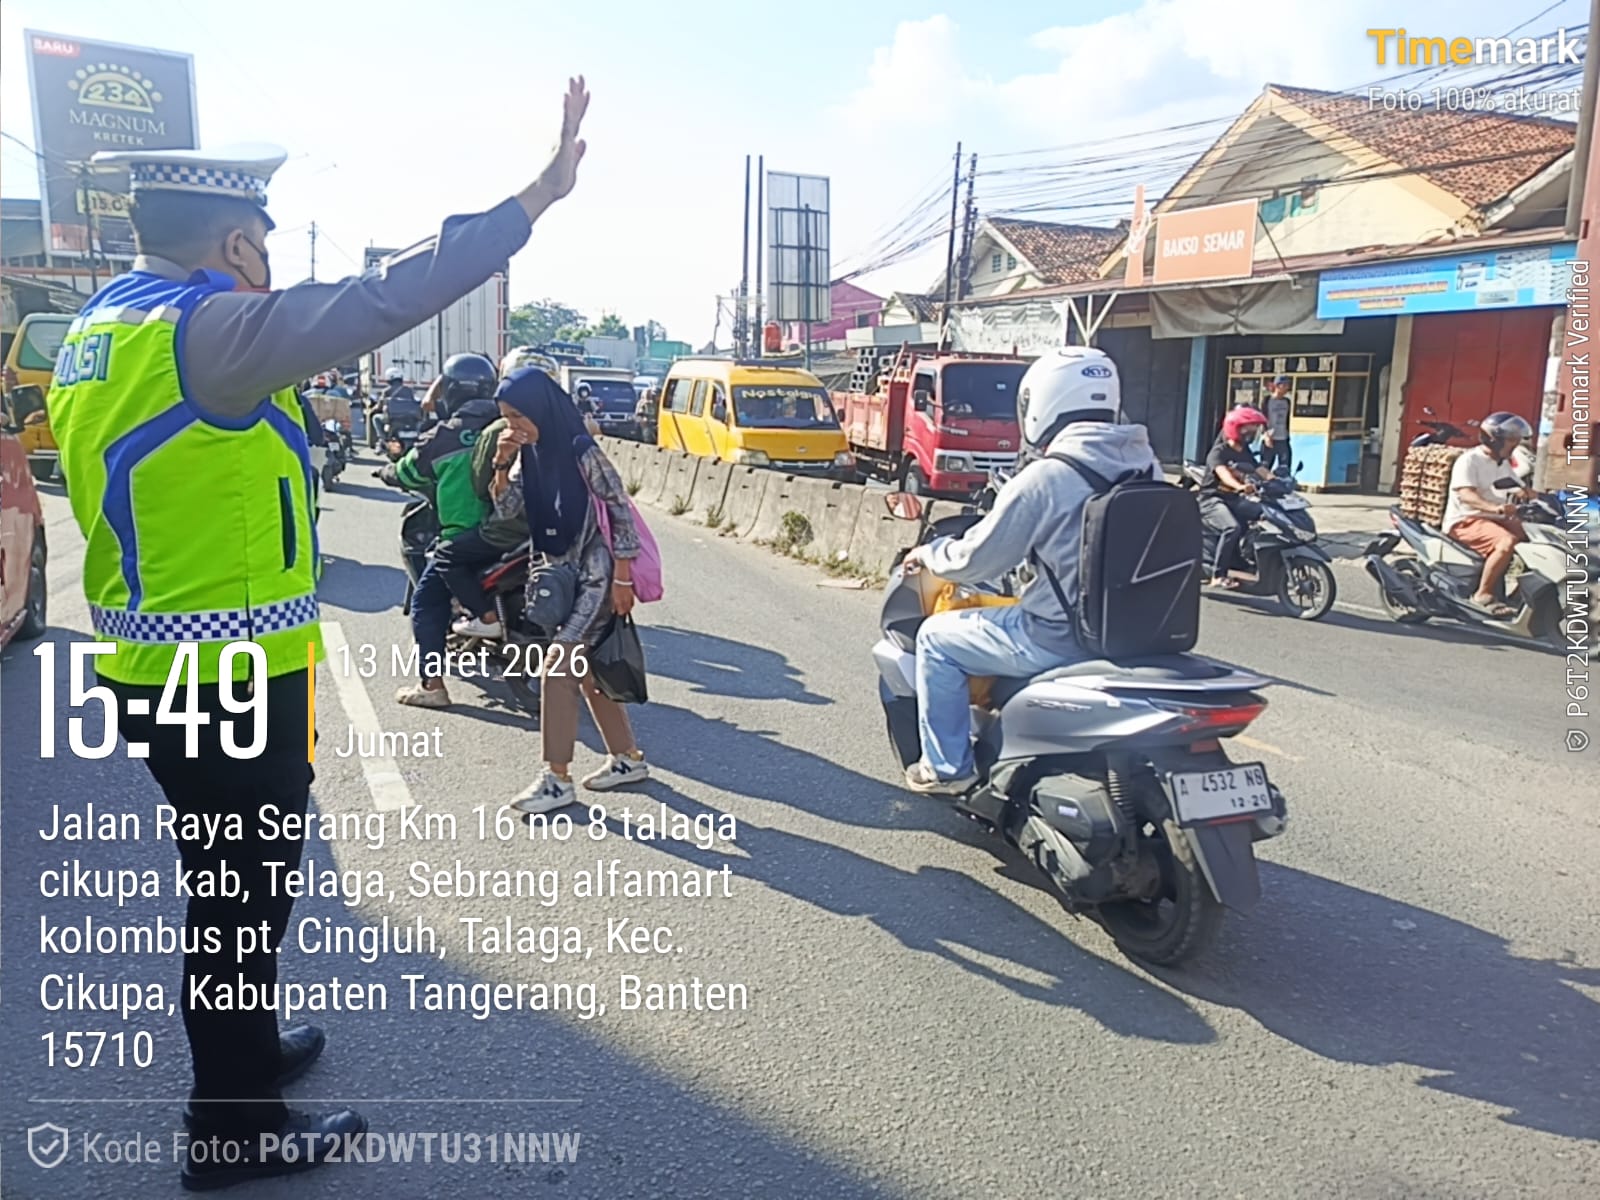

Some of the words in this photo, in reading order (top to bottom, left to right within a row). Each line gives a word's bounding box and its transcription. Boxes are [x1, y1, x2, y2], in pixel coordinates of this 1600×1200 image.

[32, 38, 74, 54] BARU
[88, 82, 143, 106] 234
[69, 109, 165, 136] MAGNUM
[94, 131, 145, 146] KRETEK
[1162, 236, 1199, 257] BAKSO
[1203, 229, 1246, 253] SEMAR
[1180, 778, 1189, 796] A
[1201, 771, 1237, 792] 4532
